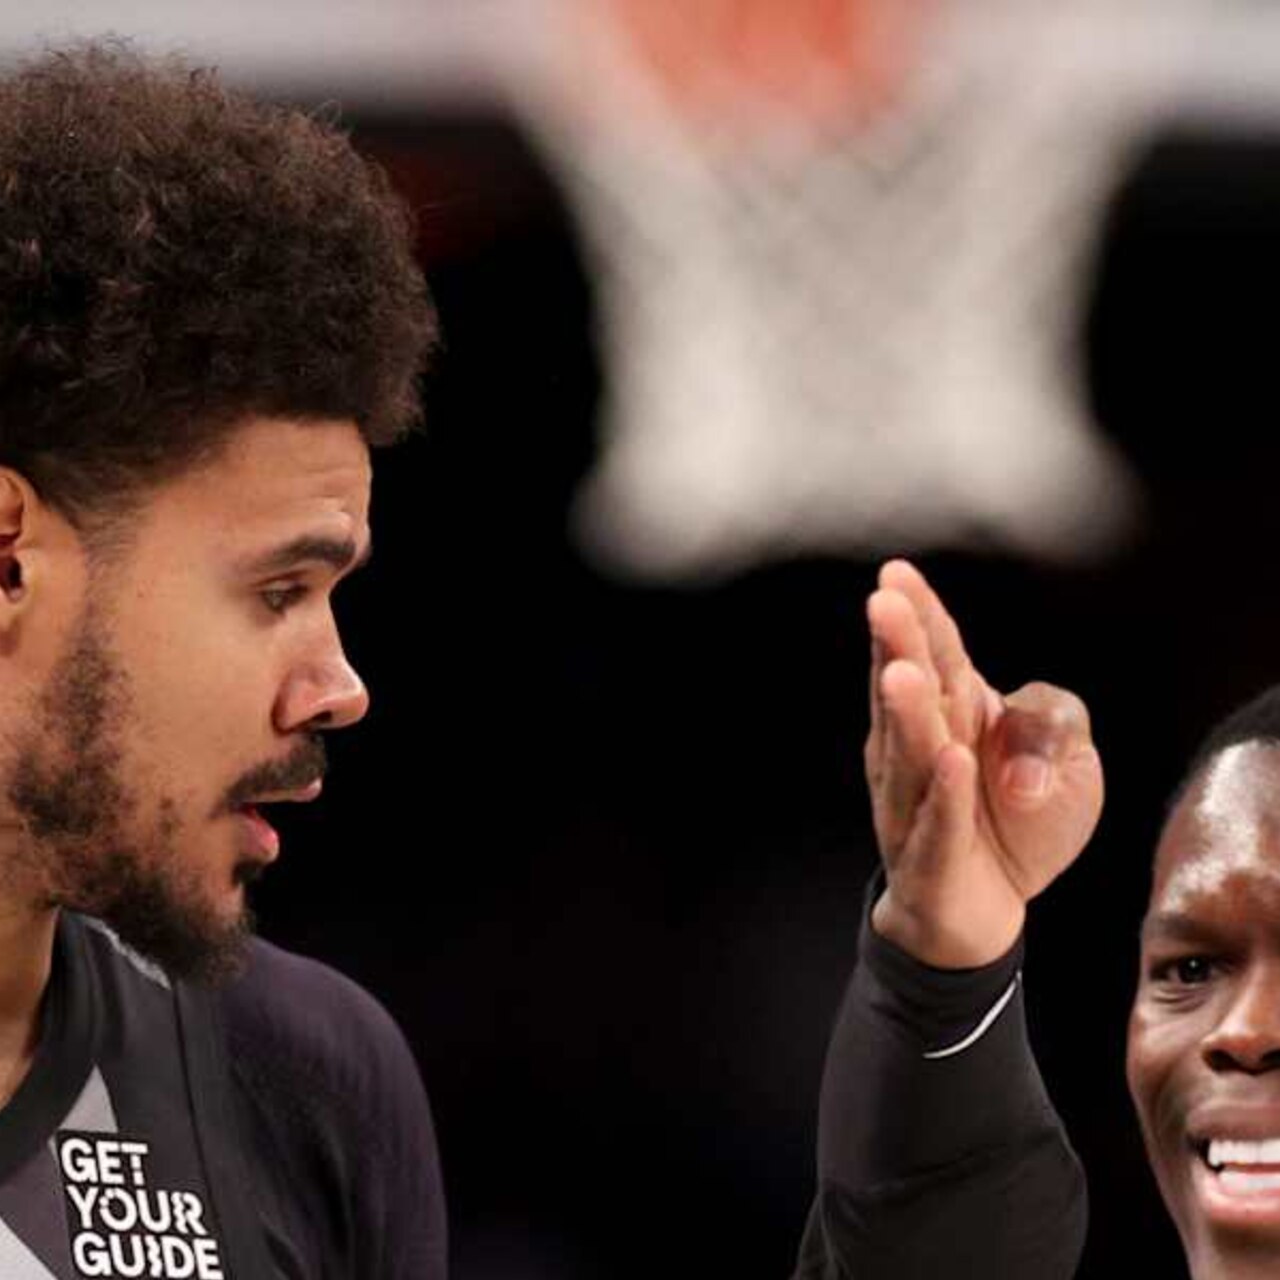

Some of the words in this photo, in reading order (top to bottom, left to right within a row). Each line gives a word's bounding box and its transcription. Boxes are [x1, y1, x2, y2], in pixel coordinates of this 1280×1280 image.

[61, 1138, 148, 1185] GET
[67, 1185, 208, 1235] YOUR
[73, 1231, 224, 1280] GUIDE
